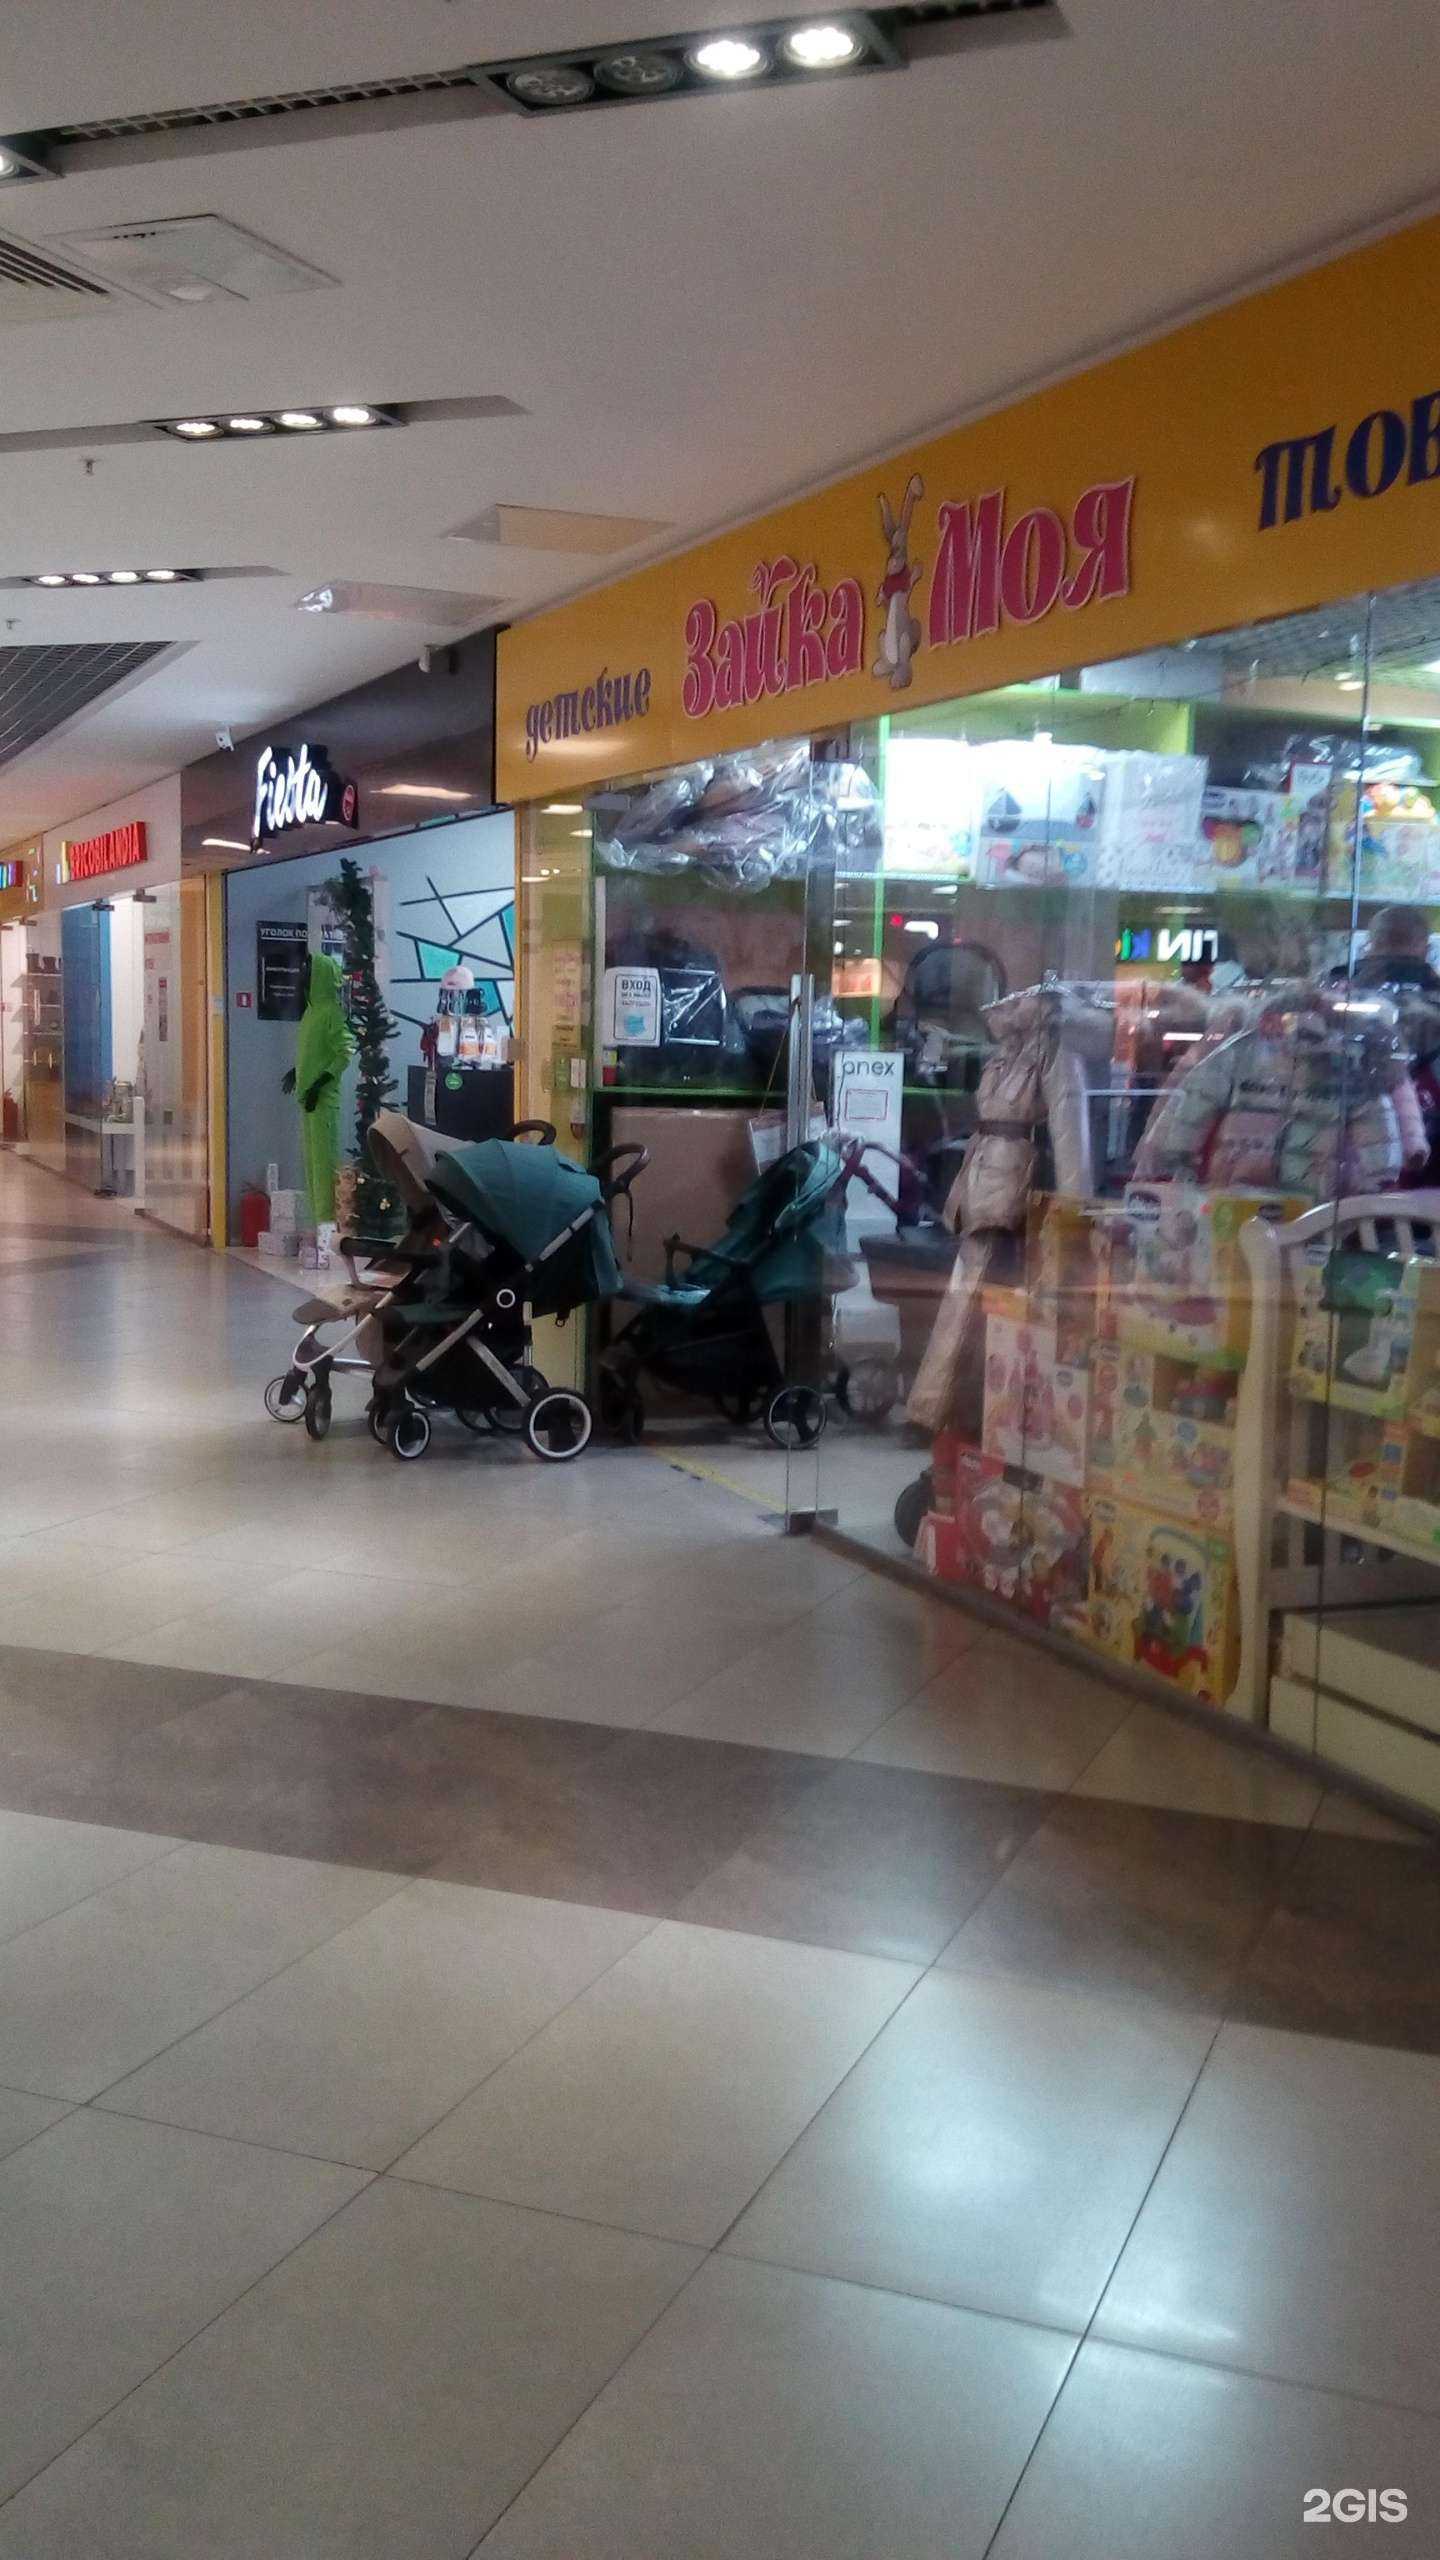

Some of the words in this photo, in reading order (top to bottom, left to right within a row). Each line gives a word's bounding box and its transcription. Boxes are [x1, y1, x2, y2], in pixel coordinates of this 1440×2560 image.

[526, 666, 651, 764] детские
[682, 555, 865, 720] Зайка
[253, 743, 328, 838] Fiesta
[621, 979, 651, 992] ВХОД
[843, 1060, 895, 1075] anex
